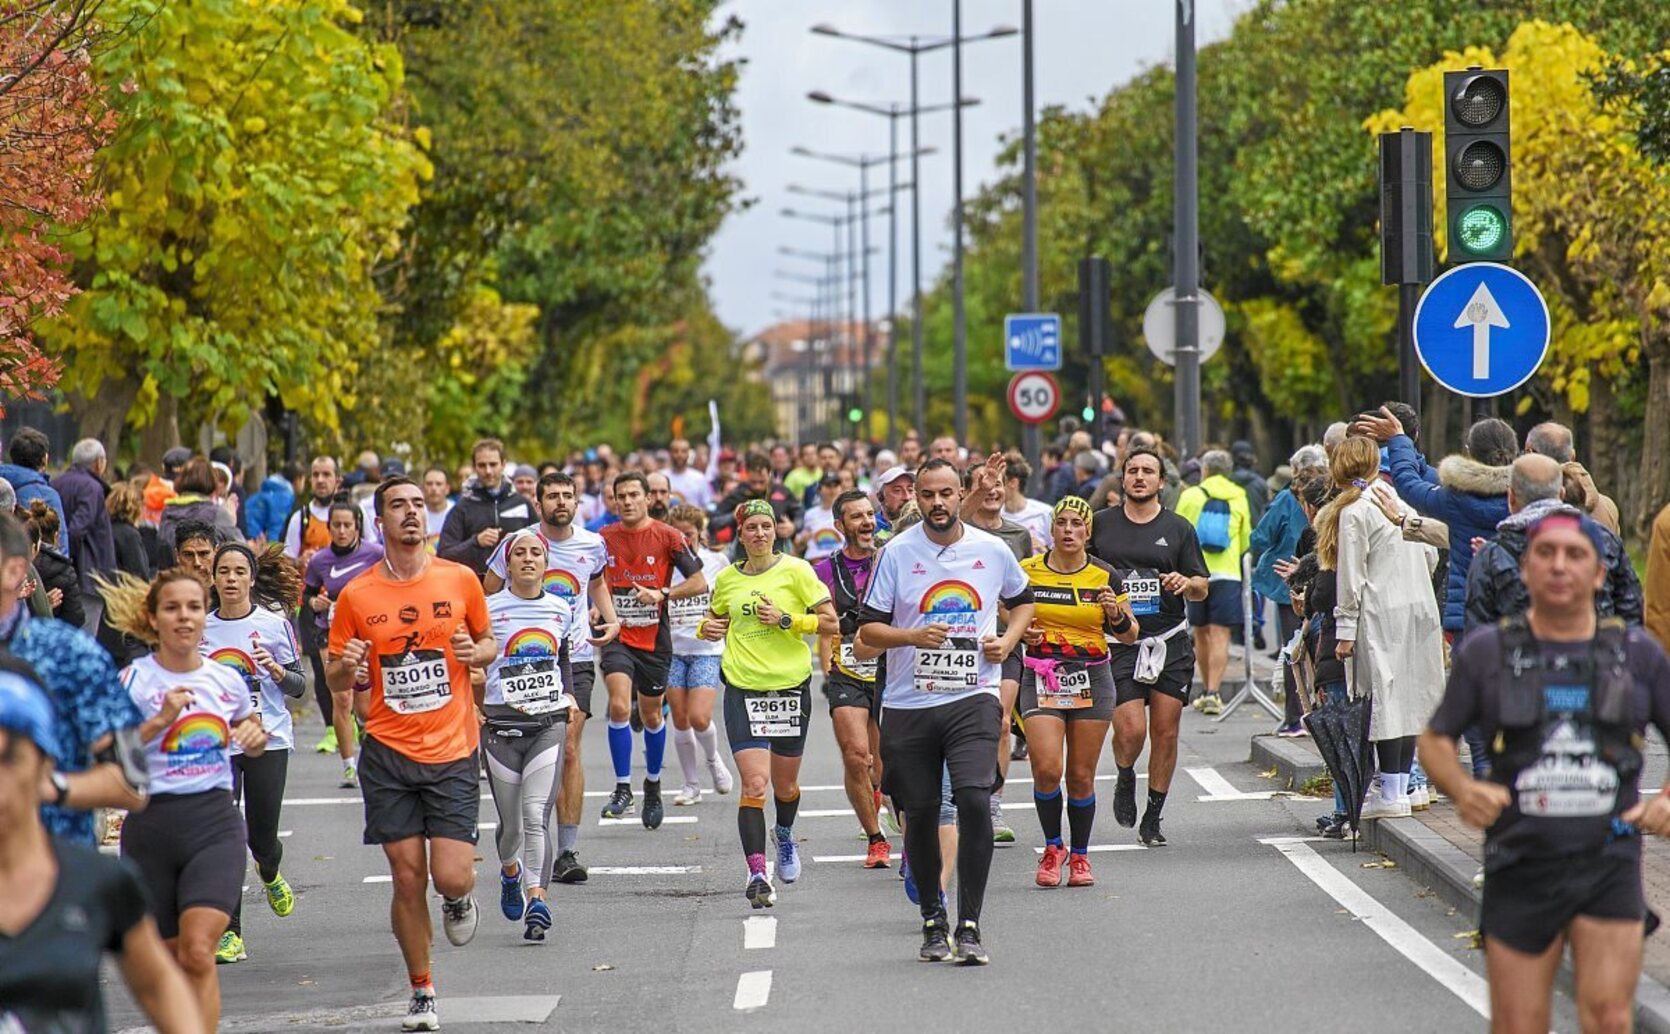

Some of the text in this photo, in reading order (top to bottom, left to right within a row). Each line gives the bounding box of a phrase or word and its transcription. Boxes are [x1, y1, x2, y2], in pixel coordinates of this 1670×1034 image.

[1020, 387, 1049, 407] 50
[671, 597, 709, 609] 32295
[920, 653, 975, 667] 27148
[387, 663, 445, 686] 33016
[506, 674, 554, 693] 30292
[751, 700, 798, 713] 29619
